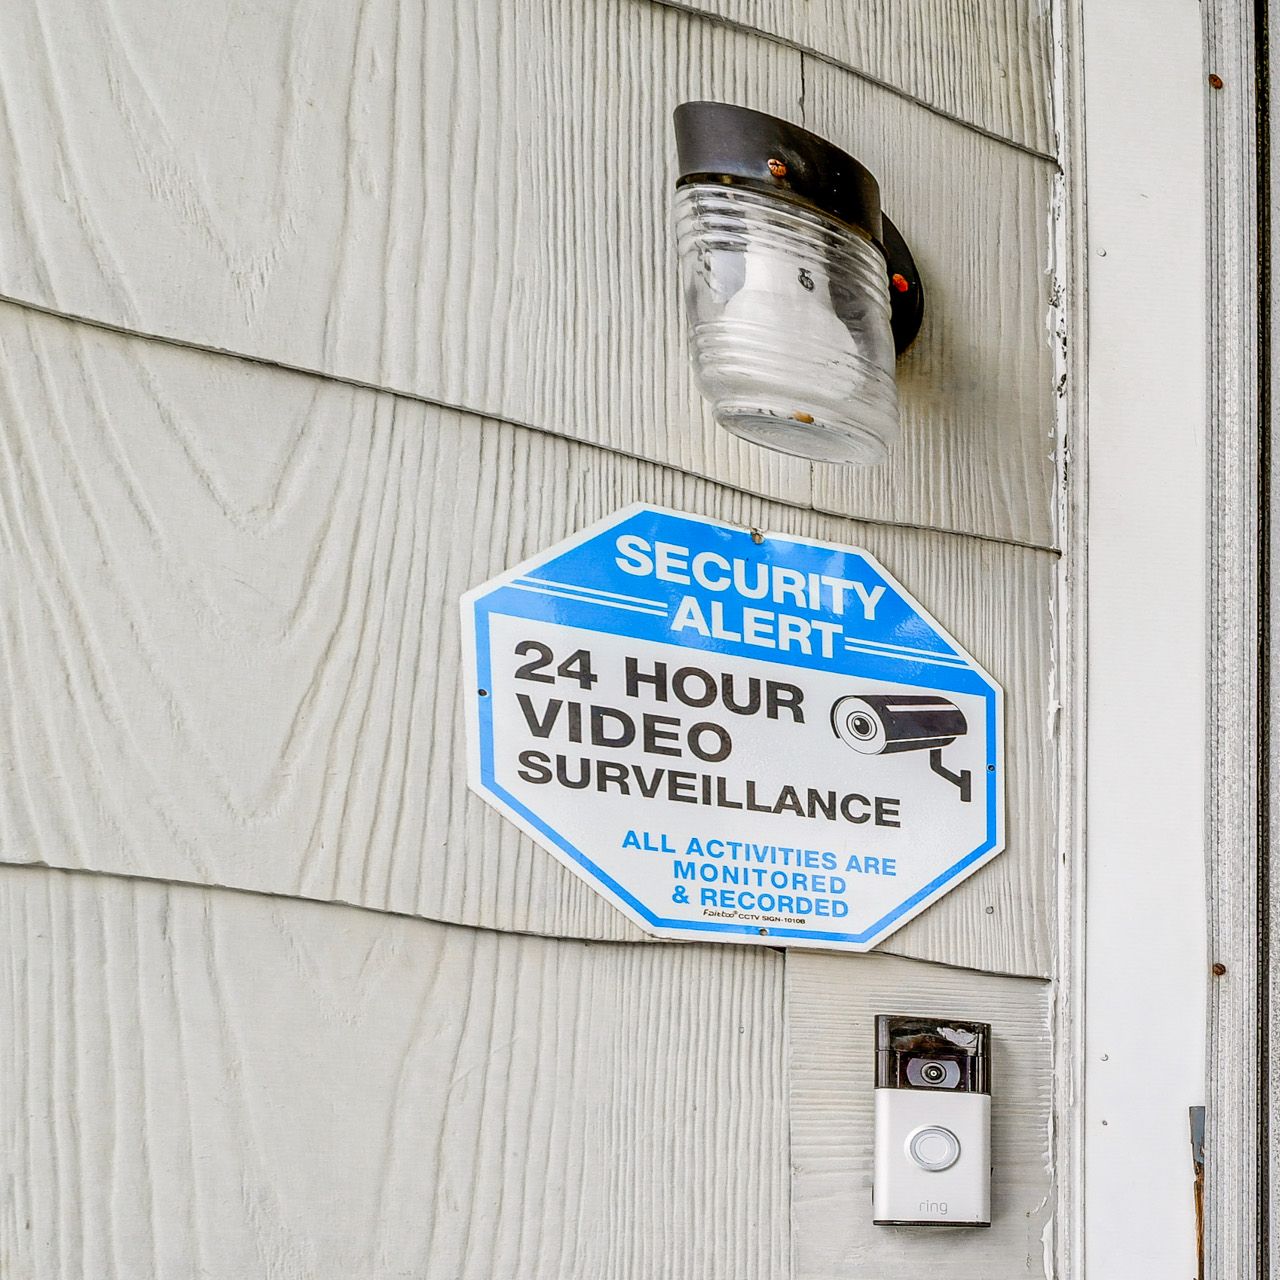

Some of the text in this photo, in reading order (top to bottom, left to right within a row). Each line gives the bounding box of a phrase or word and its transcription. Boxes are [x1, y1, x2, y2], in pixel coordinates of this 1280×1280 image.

[615, 534, 887, 621] SECURITY
[670, 595, 843, 659] ALERT
[514, 640, 806, 725] 24 HOUR
[515, 693, 733, 763] VIDEO
[517, 749, 902, 828] SURVEILLANCE
[621, 830, 897, 876] ALL ACTIVITIES ARE
[673, 860, 847, 895] MONITORED
[671, 885, 849, 918] & RECORDED
[919, 1200, 948, 1215] ring
